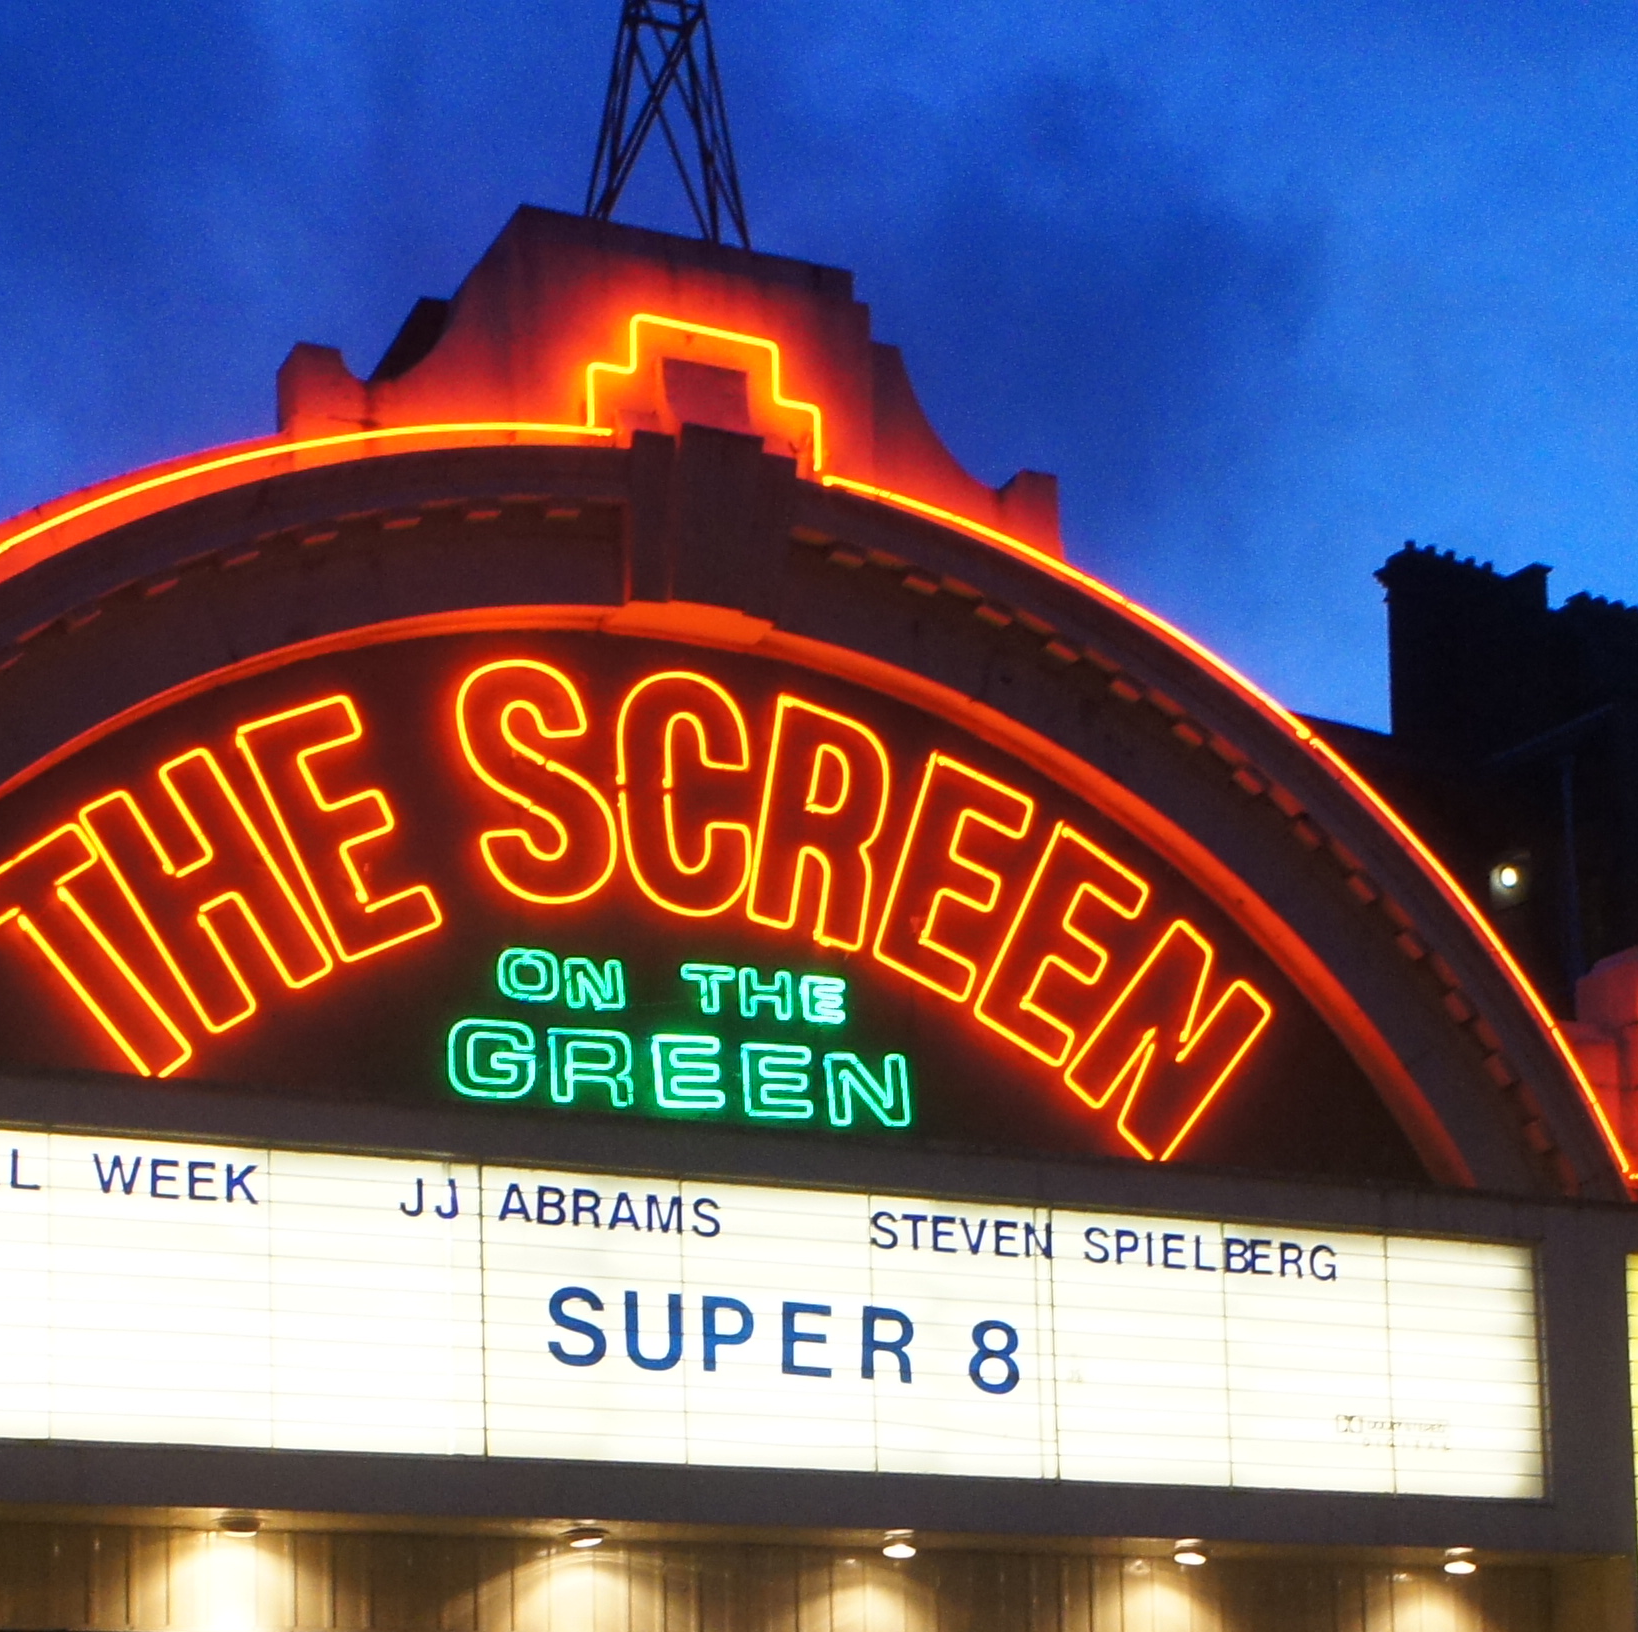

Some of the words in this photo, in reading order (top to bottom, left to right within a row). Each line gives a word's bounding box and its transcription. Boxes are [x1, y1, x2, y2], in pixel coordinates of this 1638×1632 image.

[455, 659, 1273, 1162] SCREEN
[497, 947, 626, 1011] ON
[681, 963, 846, 1025] THE
[447, 1019, 911, 1127] GREEN
[94, 1153, 259, 1205] WEEK
[400, 1178, 460, 1219] JJ
[498, 1184, 722, 1238] ABRAMS
[870, 1211, 1054, 1261] STEVEN
[1082, 1228, 1338, 1282] SPIELBERG
[547, 1286, 915, 1383] SUPER
[968, 1320, 1020, 1394] 8
